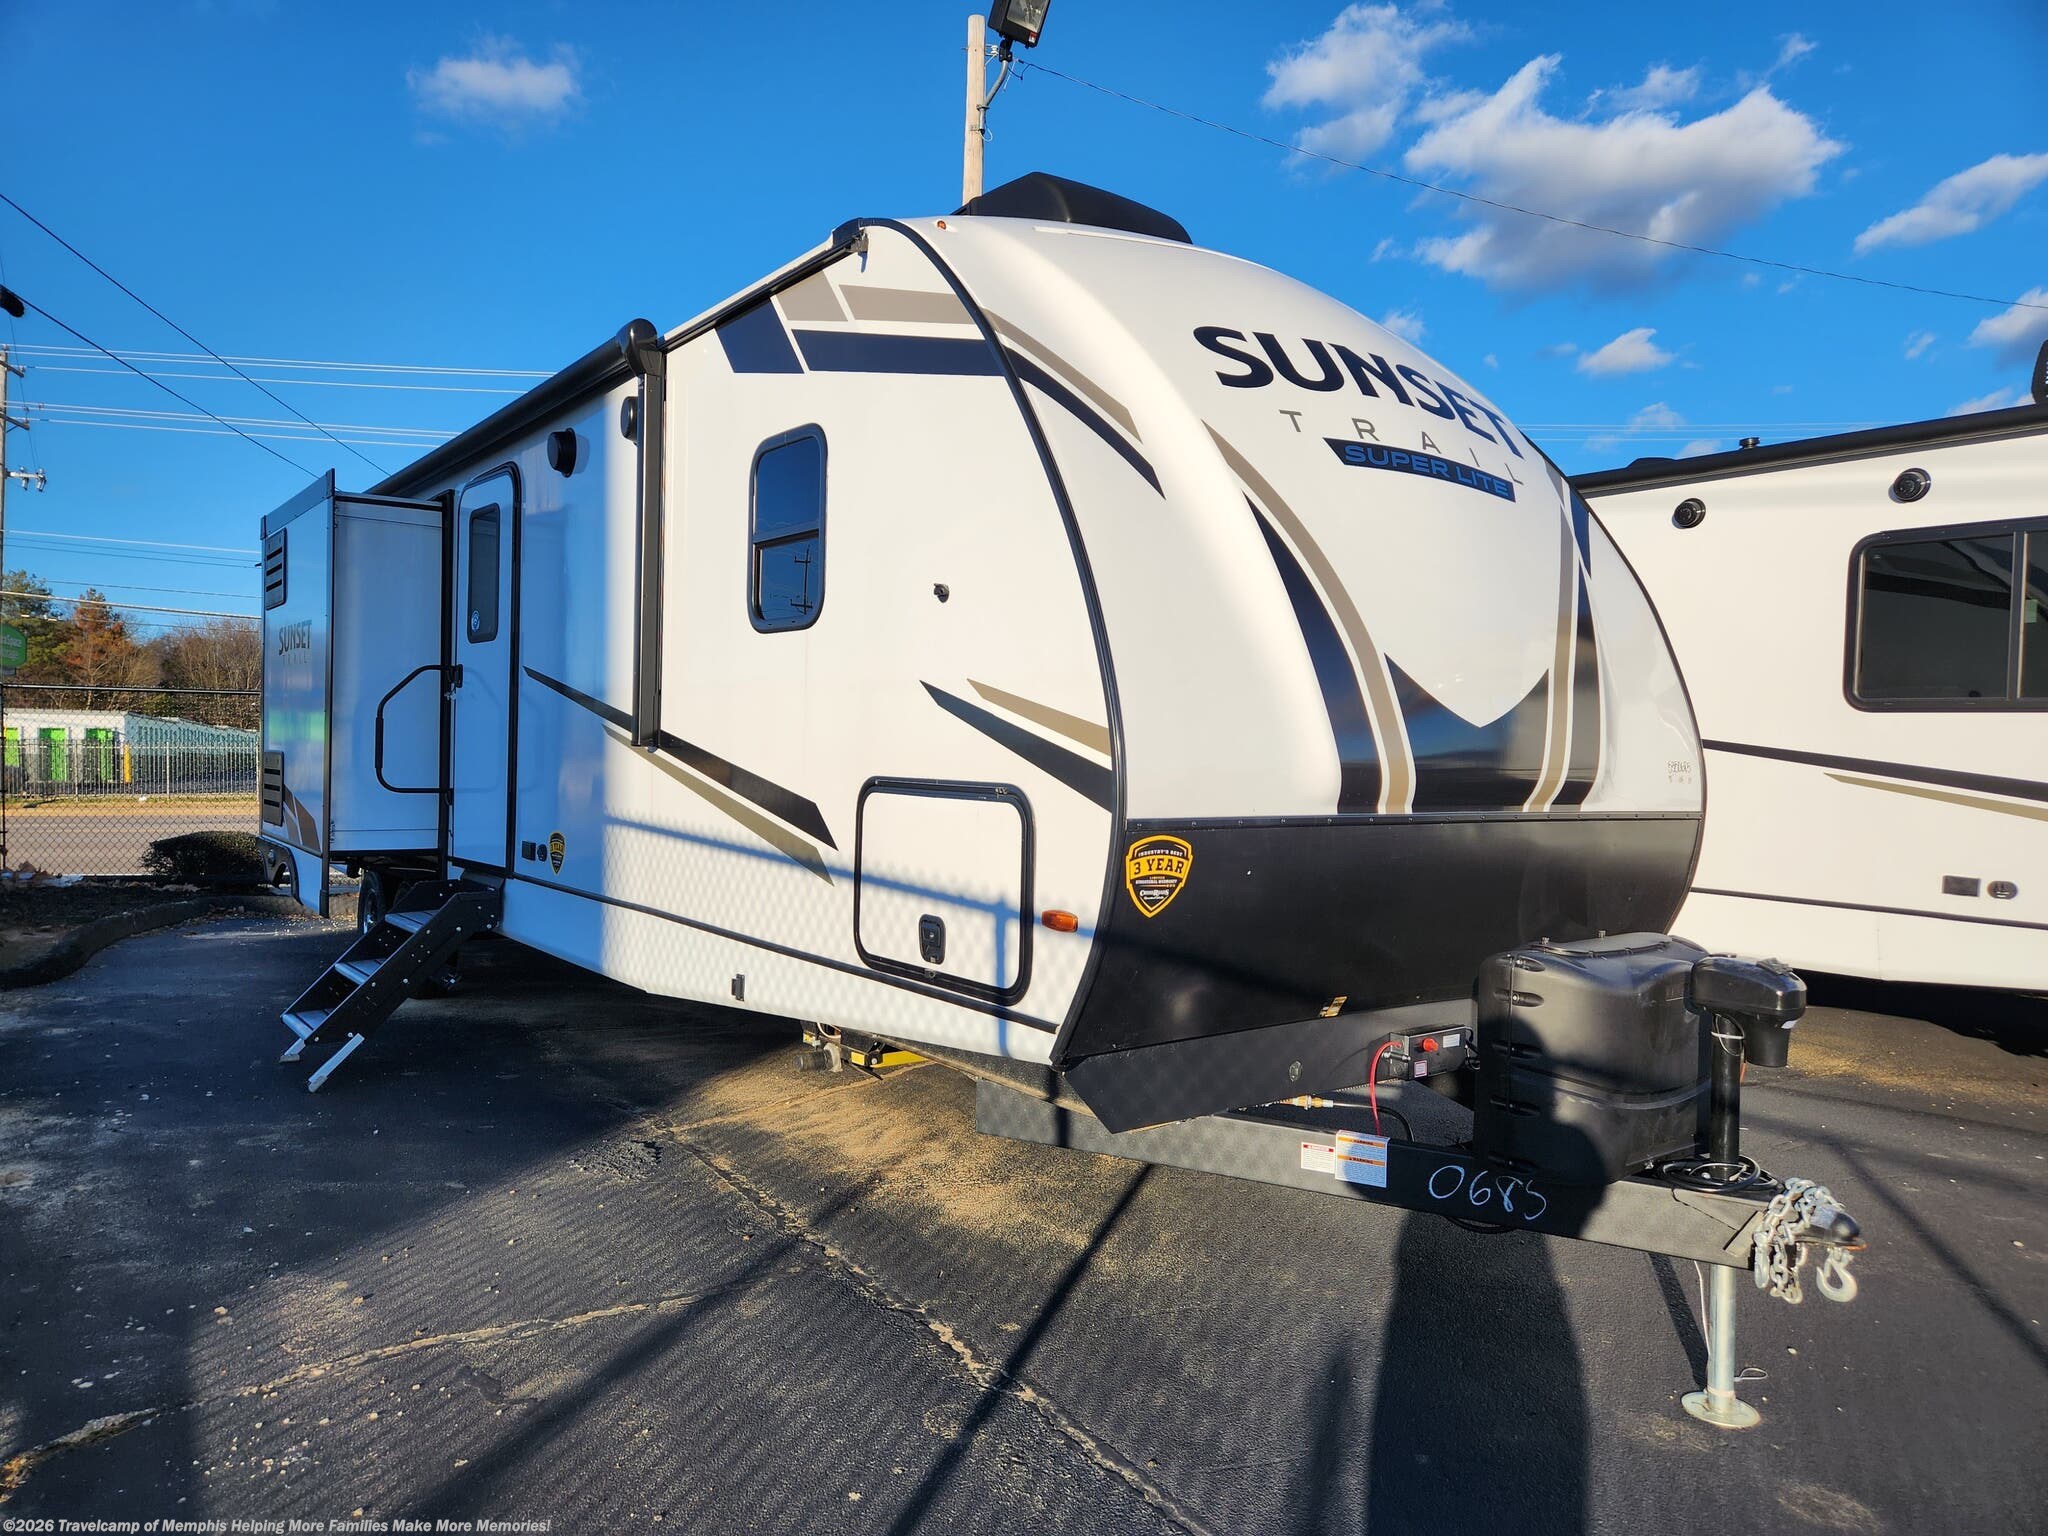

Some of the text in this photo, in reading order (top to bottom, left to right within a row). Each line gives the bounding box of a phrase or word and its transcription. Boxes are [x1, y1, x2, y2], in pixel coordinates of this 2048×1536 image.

[1193, 326, 1525, 460] SUNSET
[1279, 409, 1525, 486] TRAIL
[1345, 445, 1510, 497] SUPER LITE
[278, 619, 313, 656] SUNSET
[1134, 858, 1184, 876] 3 YEAR
[1428, 1164, 1547, 1221] 0685
